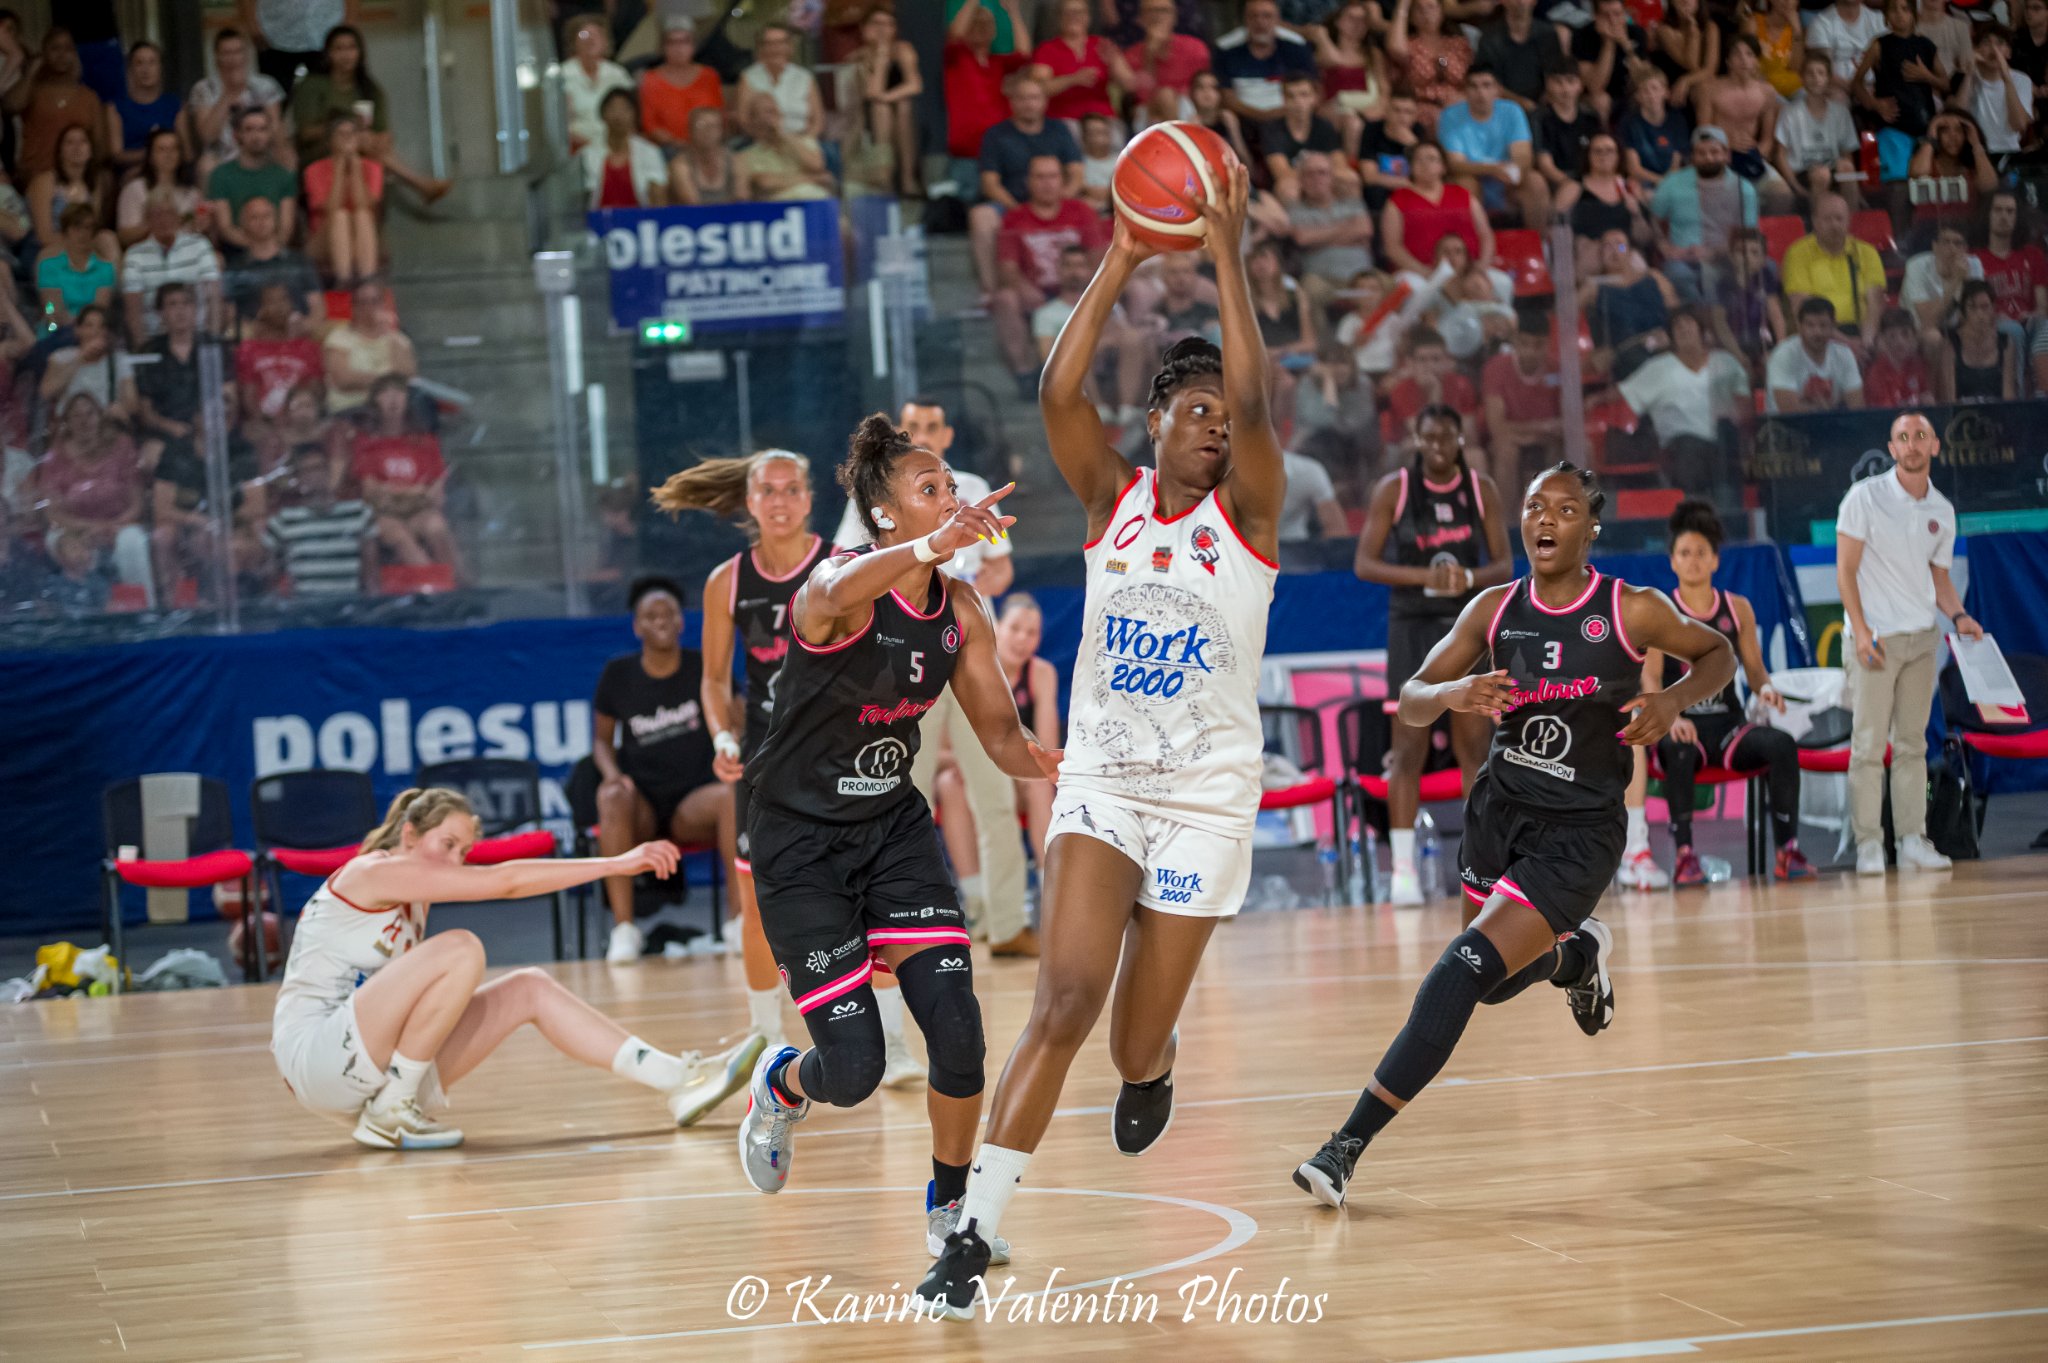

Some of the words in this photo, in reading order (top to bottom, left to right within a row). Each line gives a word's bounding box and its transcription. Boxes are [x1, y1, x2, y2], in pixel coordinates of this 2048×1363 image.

[772, 604, 787, 630] 7
[1106, 615, 1212, 674] Work
[1542, 640, 1563, 670] 3
[910, 651, 925, 683] 5
[1110, 663, 1185, 698] 2000
[253, 698, 593, 778] polesu
[1506, 752, 1573, 778] PROMOTION
[1156, 868, 1203, 893] Work
[1159, 888, 1192, 904] 2000
